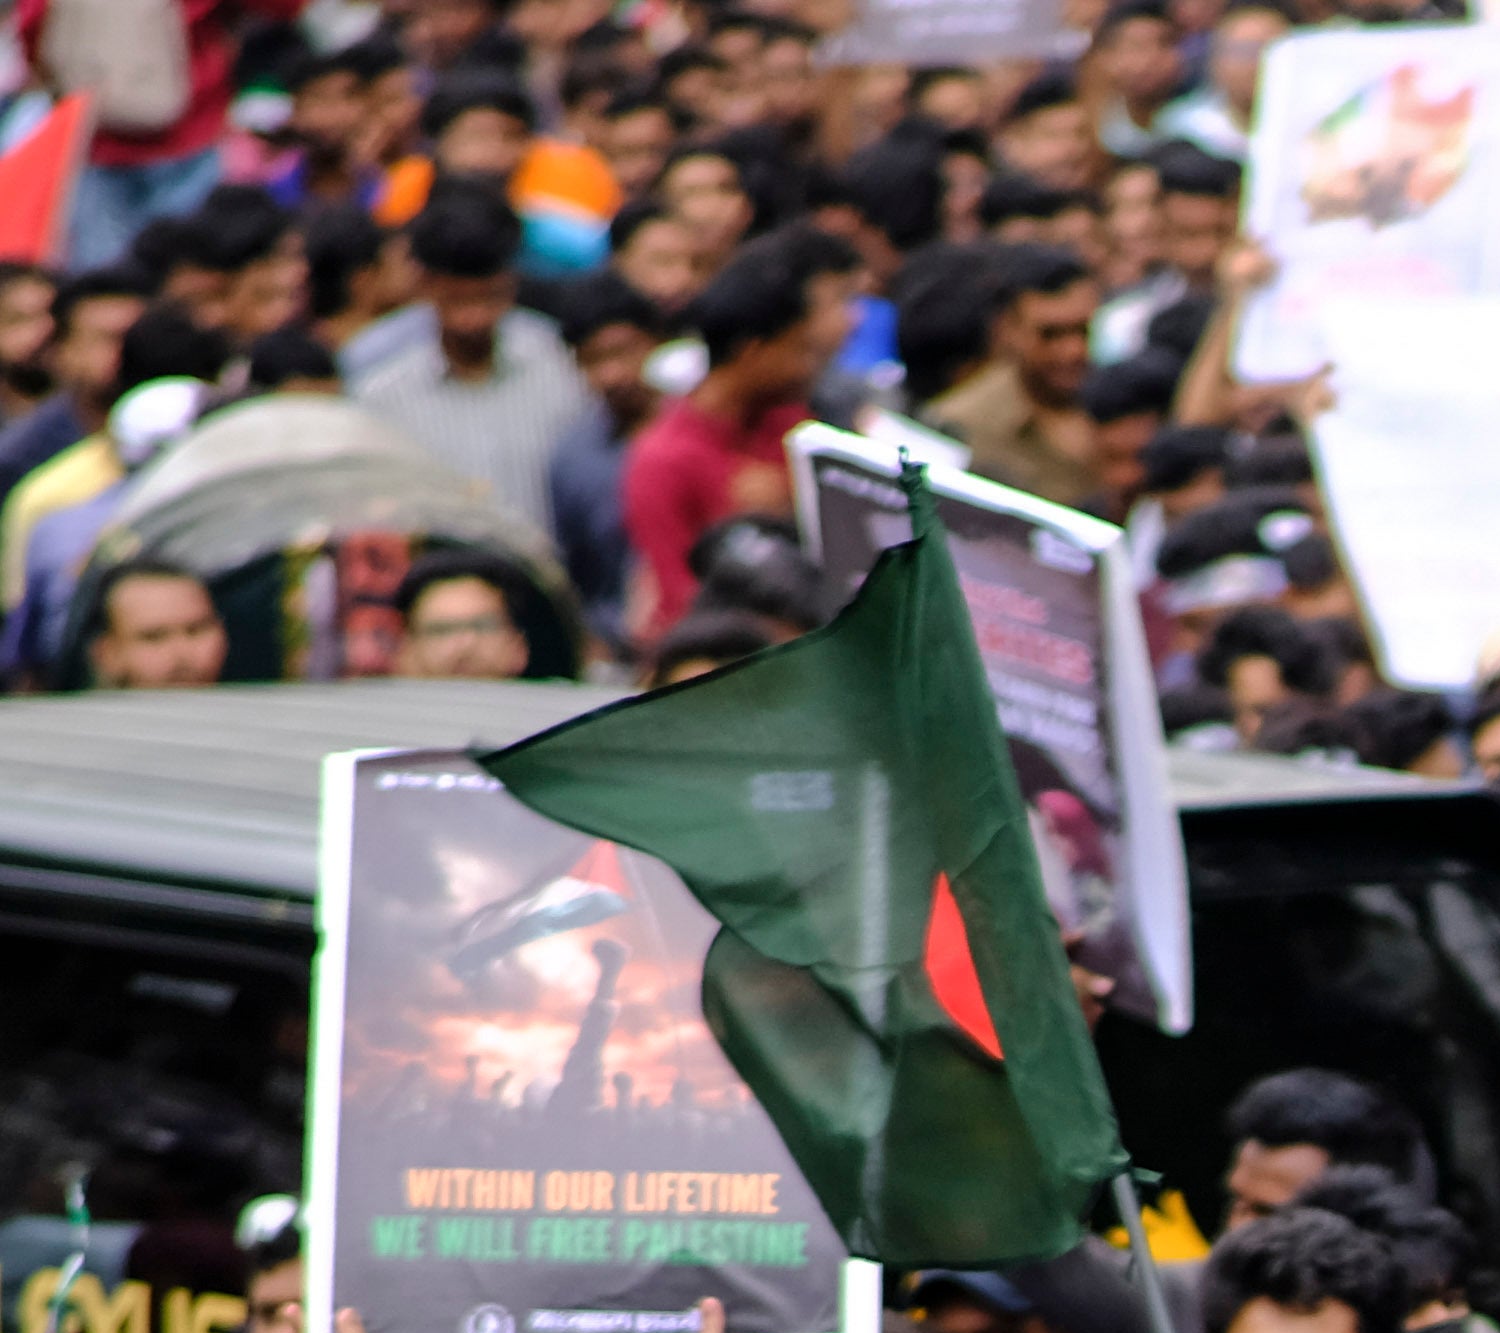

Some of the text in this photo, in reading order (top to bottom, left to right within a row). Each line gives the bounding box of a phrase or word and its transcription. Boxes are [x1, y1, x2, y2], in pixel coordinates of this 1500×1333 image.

[407, 1168, 781, 1214] WITHIN OUR LIFETIME
[371, 1215, 809, 1268] WE WILL FREE PALESTINE
